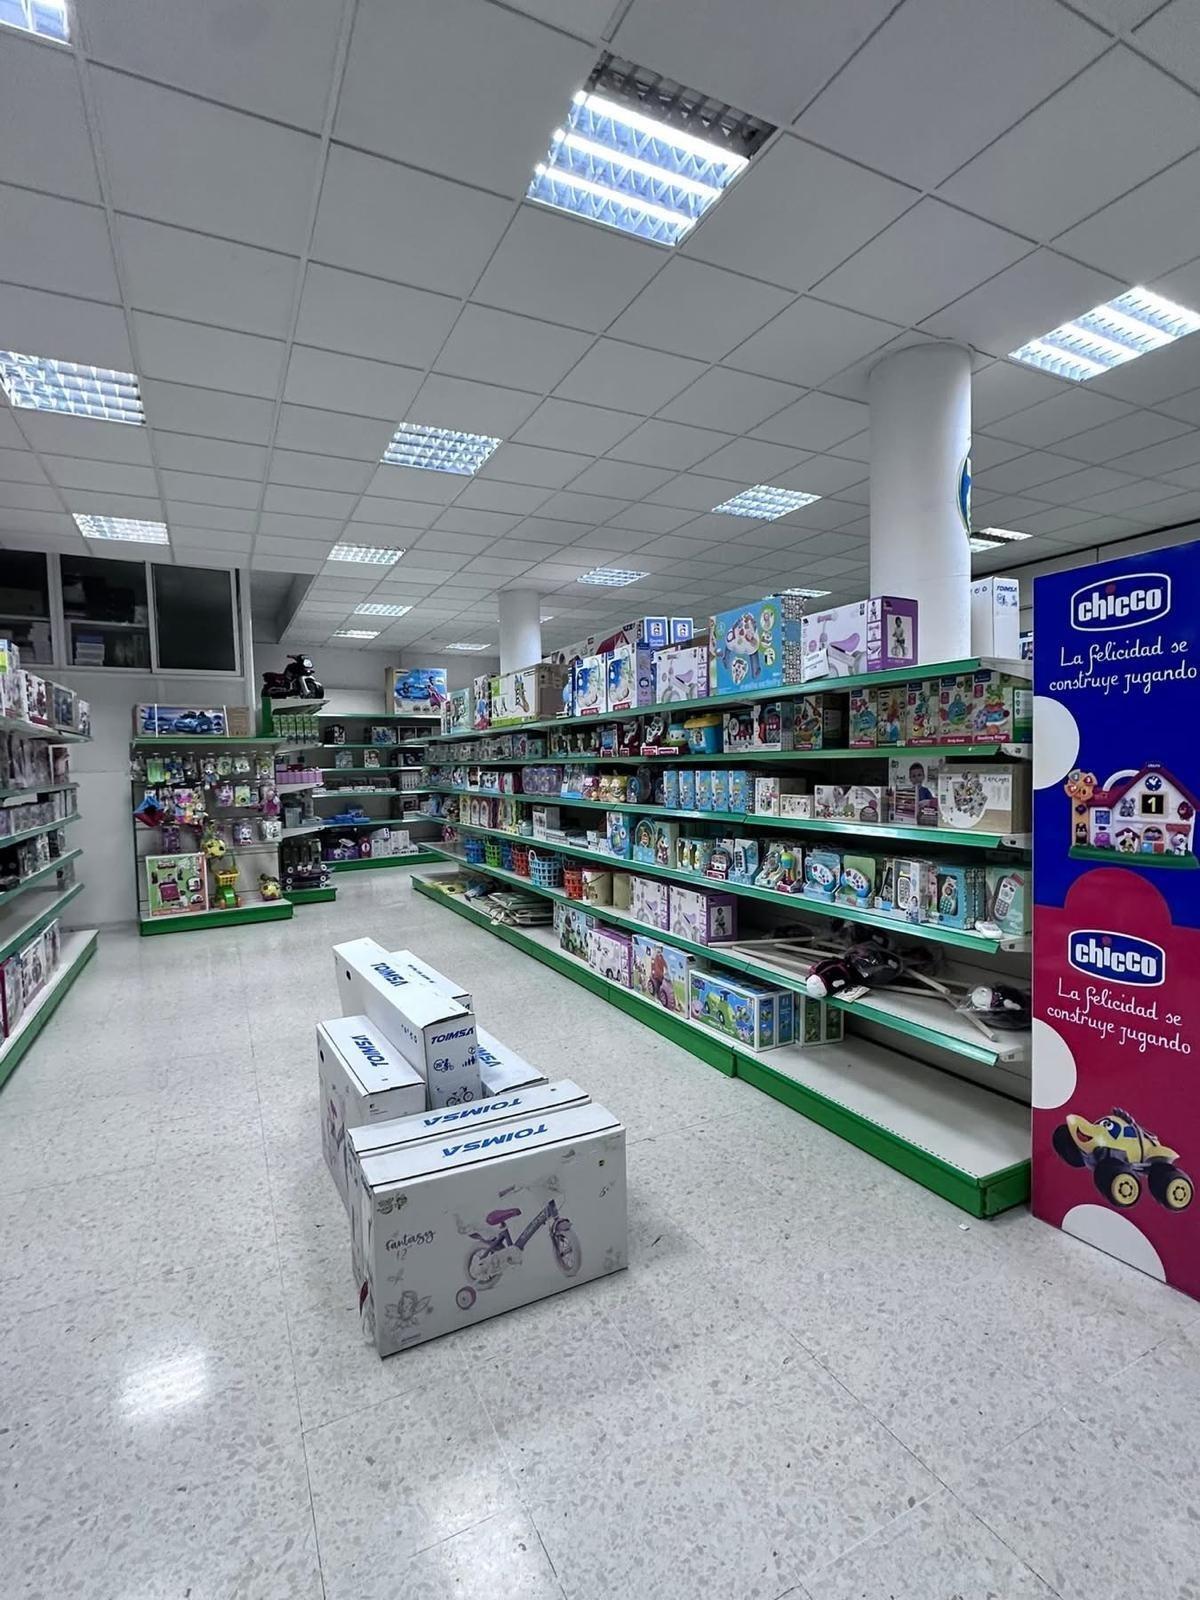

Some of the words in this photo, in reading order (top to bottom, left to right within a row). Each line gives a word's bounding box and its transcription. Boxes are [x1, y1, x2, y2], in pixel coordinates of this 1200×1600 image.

[1078, 584, 1162, 622] chicco
[1060, 646, 1084, 667] La
[1085, 635, 1164, 676] felicidad
[1170, 640, 1189, 653] se
[1049, 670, 1119, 696] construye
[1123, 659, 1198, 694] jugando
[370, 962, 408, 987] TOIMSA
[1075, 936, 1157, 977] chicco
[1058, 977, 1081, 1001] La
[1083, 986, 1159, 1020] felicidad
[1165, 1012, 1183, 1026] se
[431, 1026, 475, 1044] TOIMSA
[1047, 1006, 1115, 1039] construye
[1119, 1026, 1192, 1055] jugando
[350, 1034, 390, 1067] TOIMSA
[423, 1098, 522, 1127] TOIMSA
[442, 1124, 549, 1157] TOIMSA
